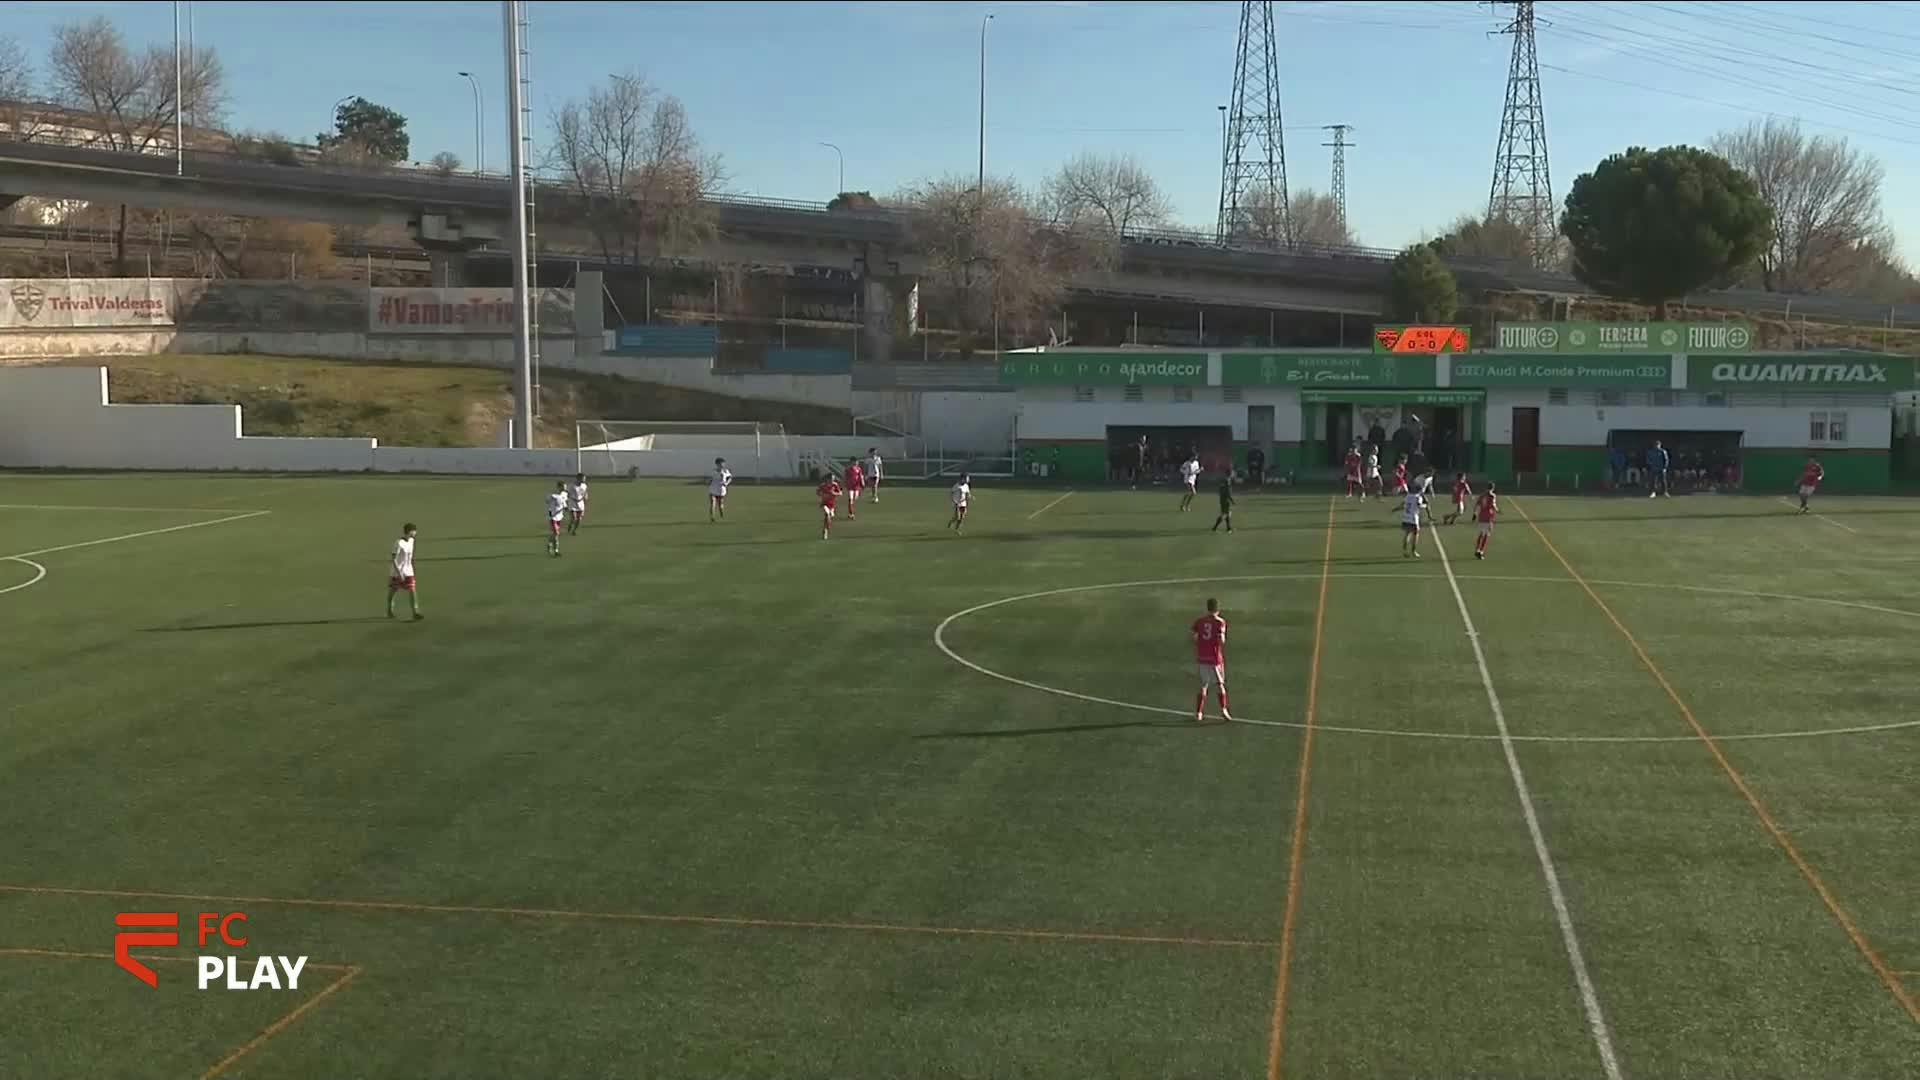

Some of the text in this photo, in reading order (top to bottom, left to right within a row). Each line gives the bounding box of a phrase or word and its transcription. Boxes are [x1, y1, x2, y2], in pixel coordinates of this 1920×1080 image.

[377, 296, 515, 325] #VamosTriv
[1599, 327, 1648, 342] TERCERA
[1004, 360, 1202, 384] GRUPO afandecor
[1487, 366, 1516, 377] Audi
[1577, 366, 1635, 377] Premium
[1712, 363, 1887, 383] QUAMTRAX
[1202, 623, 1212, 640] 3
